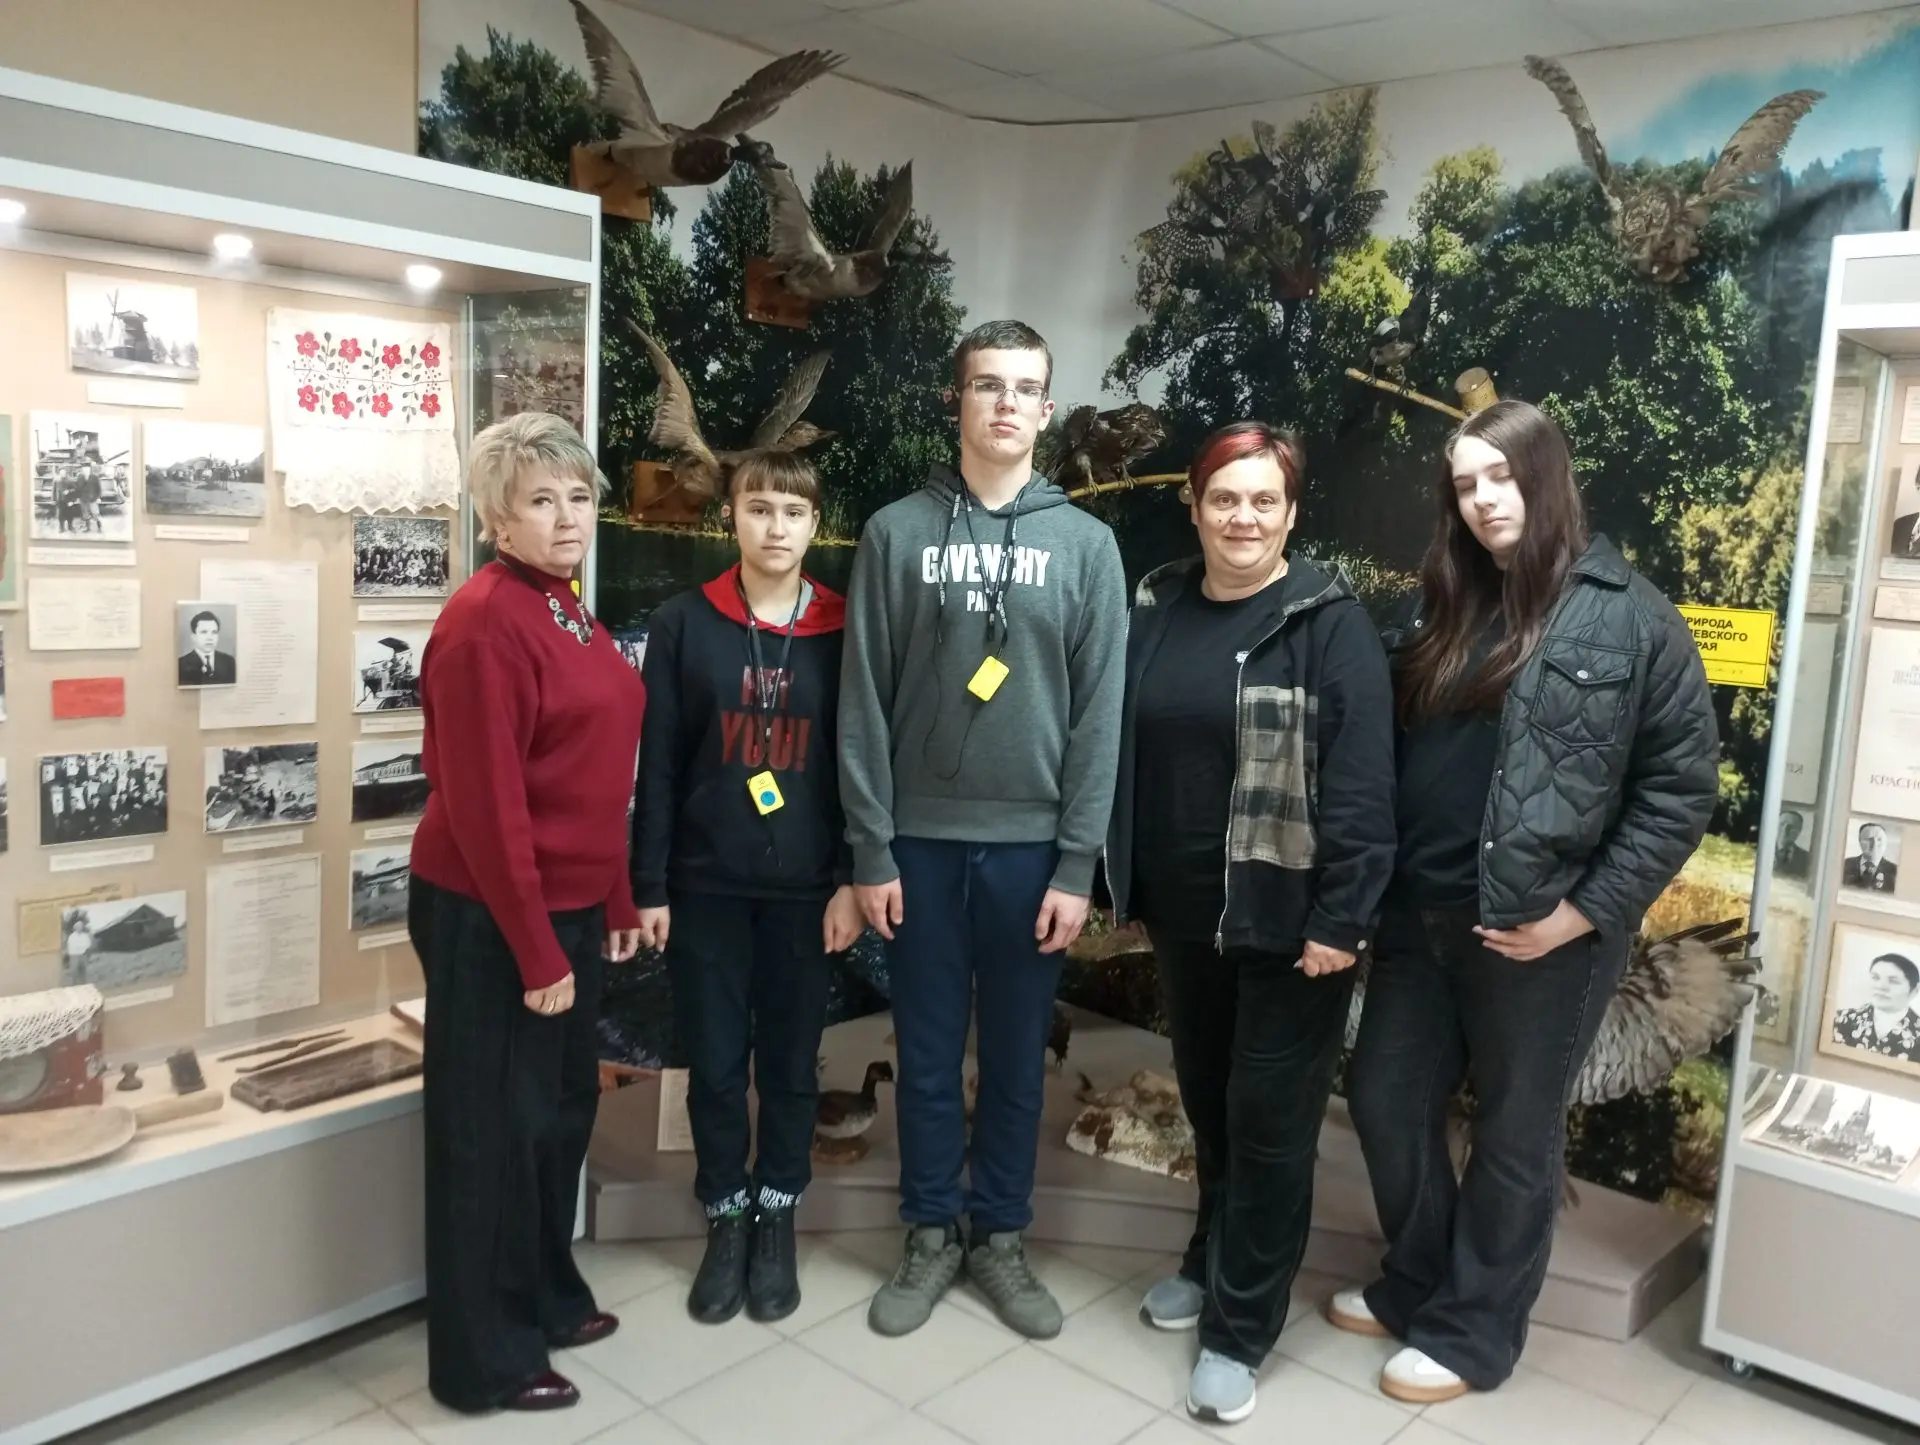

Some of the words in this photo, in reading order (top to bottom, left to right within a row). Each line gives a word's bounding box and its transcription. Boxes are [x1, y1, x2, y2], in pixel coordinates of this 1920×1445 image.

[1684, 616, 1733, 629] РИРОДА
[1690, 629, 1748, 642] ЕВСКОГО
[1696, 641, 1717, 651] РАЯ
[721, 709, 811, 772] YOU!
